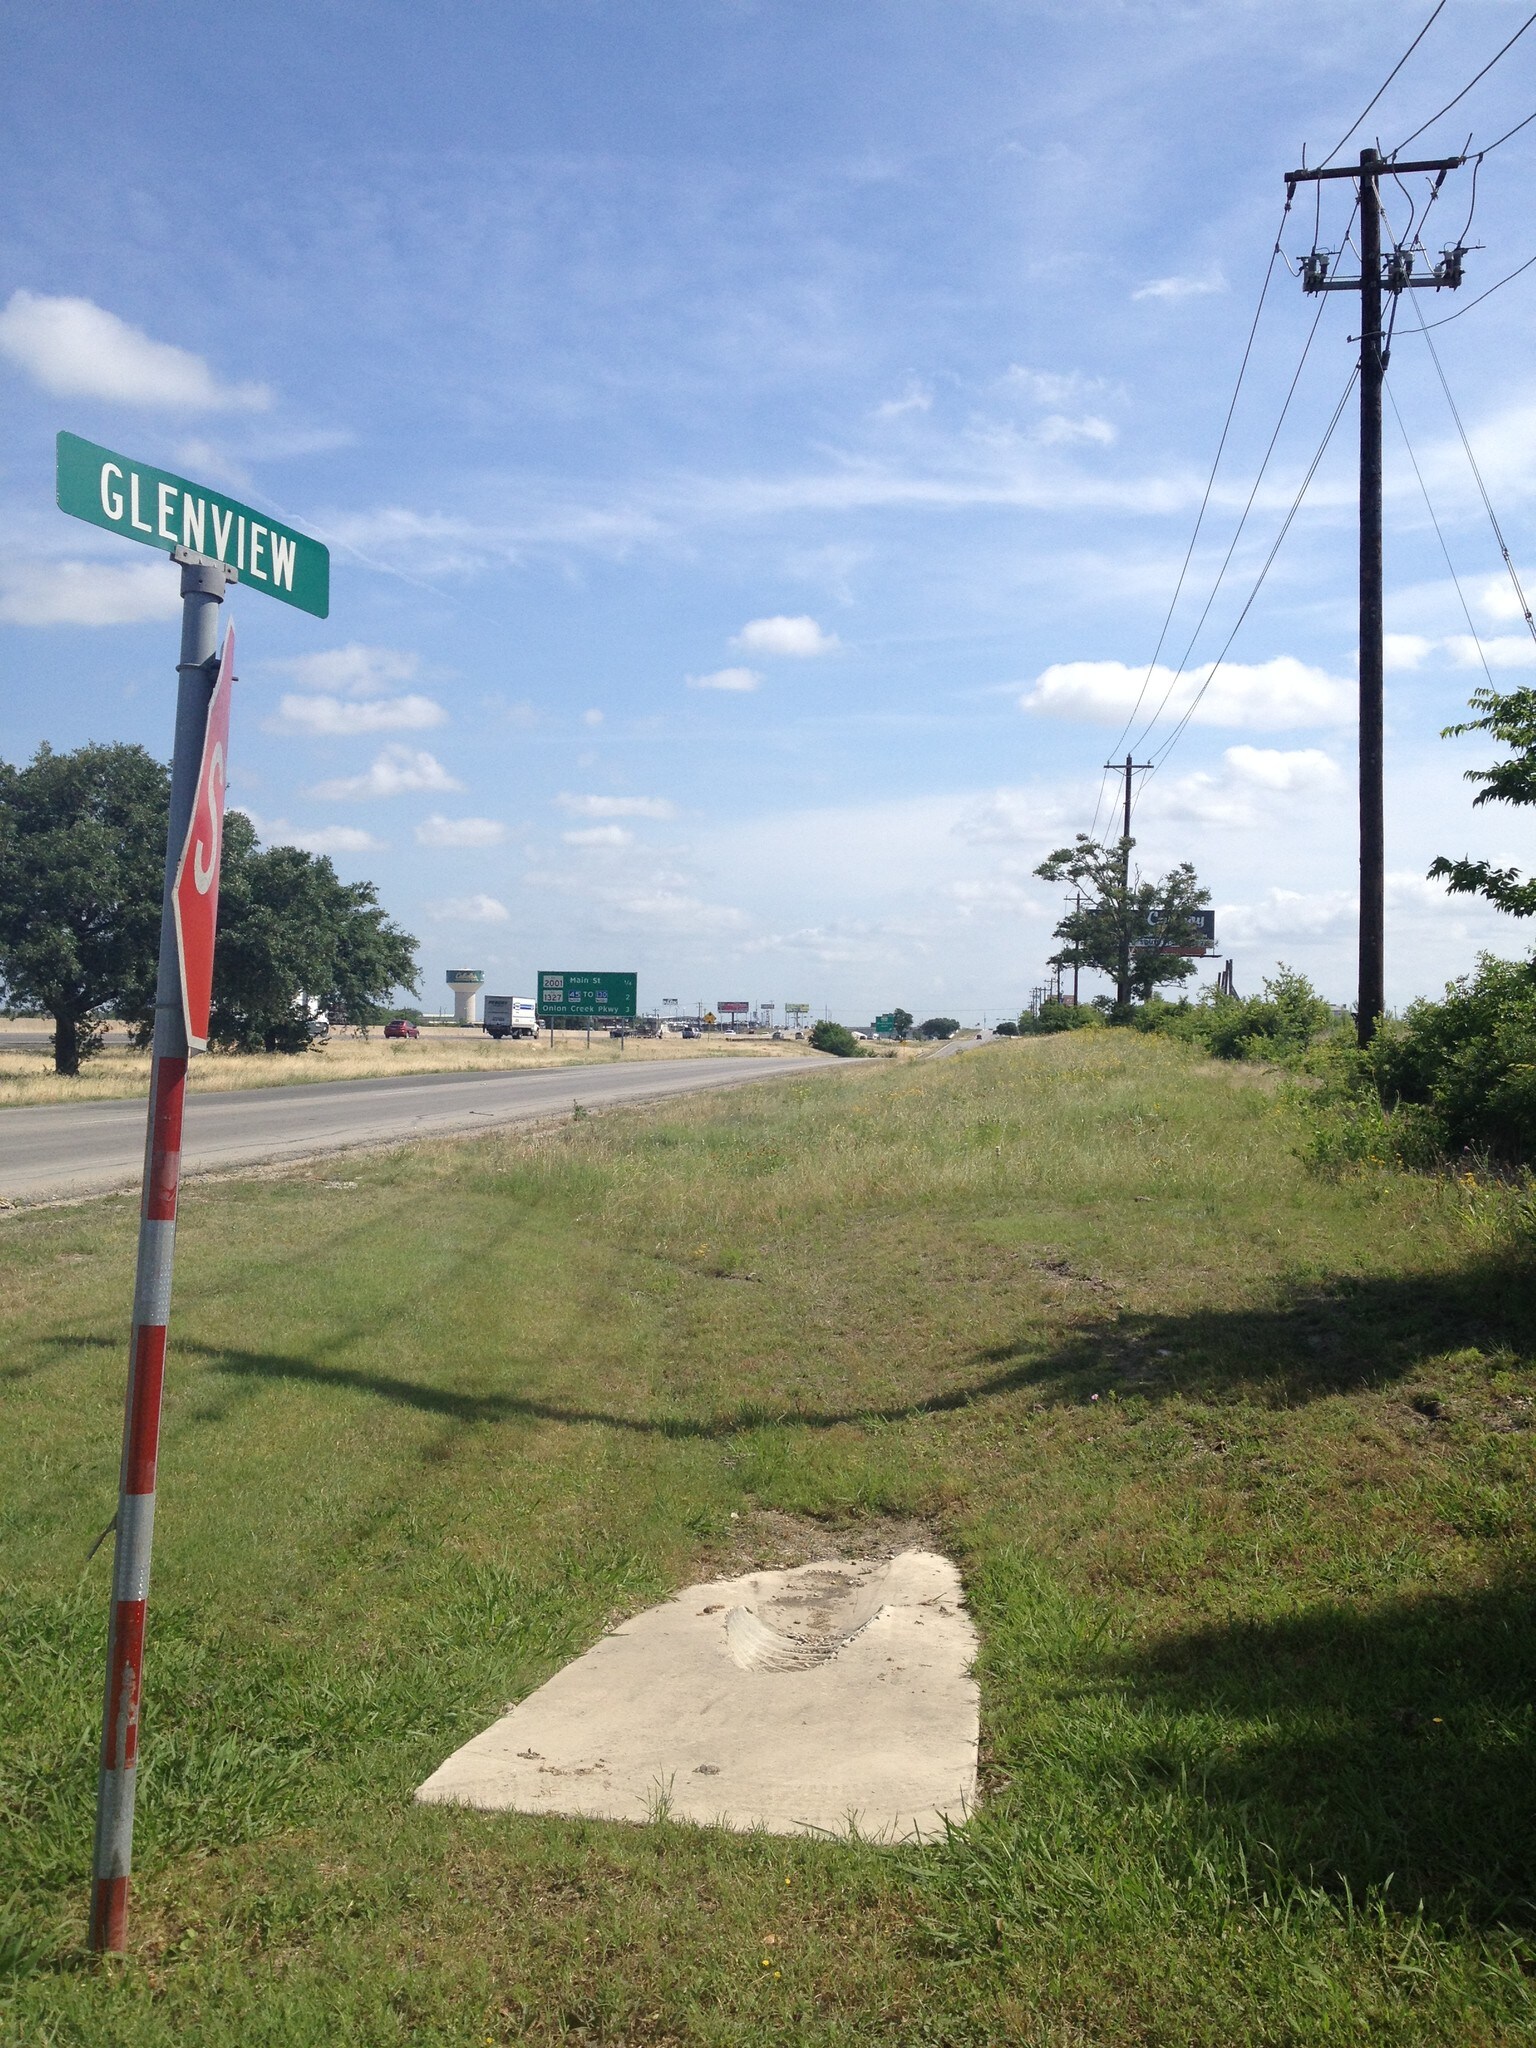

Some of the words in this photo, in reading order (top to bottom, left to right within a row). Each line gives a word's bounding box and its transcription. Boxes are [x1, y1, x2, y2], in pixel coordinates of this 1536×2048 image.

[100, 462, 297, 592] GLENVIEW
[544, 979, 563, 987] 2001
[598, 1005, 619, 1014] Pkwy
